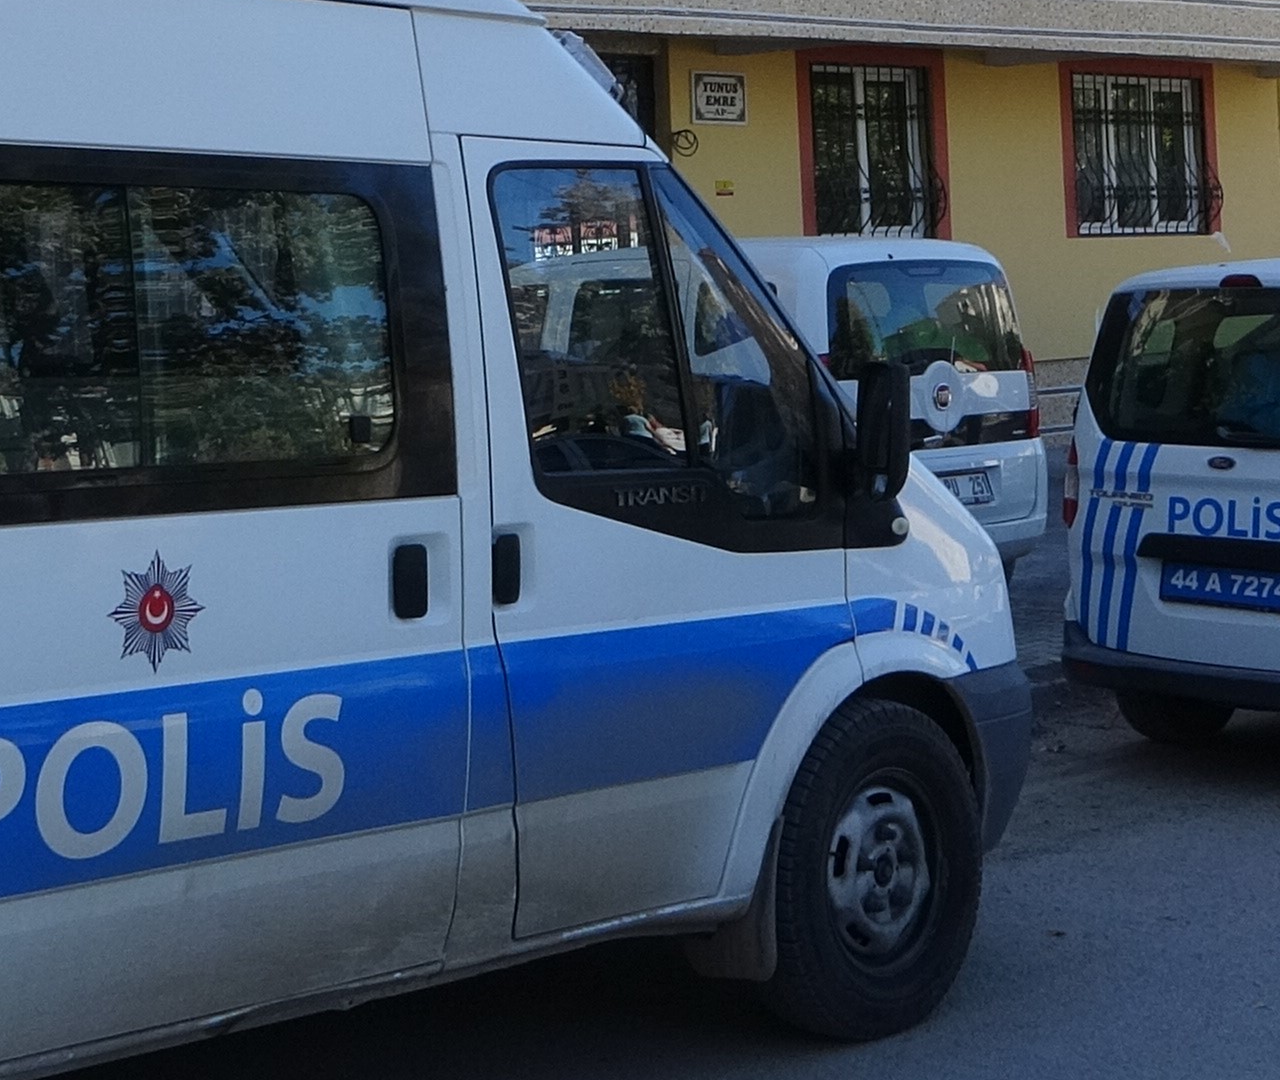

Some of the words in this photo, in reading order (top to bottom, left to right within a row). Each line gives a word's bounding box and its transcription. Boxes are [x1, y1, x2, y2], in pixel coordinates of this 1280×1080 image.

[702, 81, 739, 94] YUNUS
[704, 95, 737, 107] EMRE
[1170, 569, 1199, 591] 44
[1205, 574, 1222, 594] A
